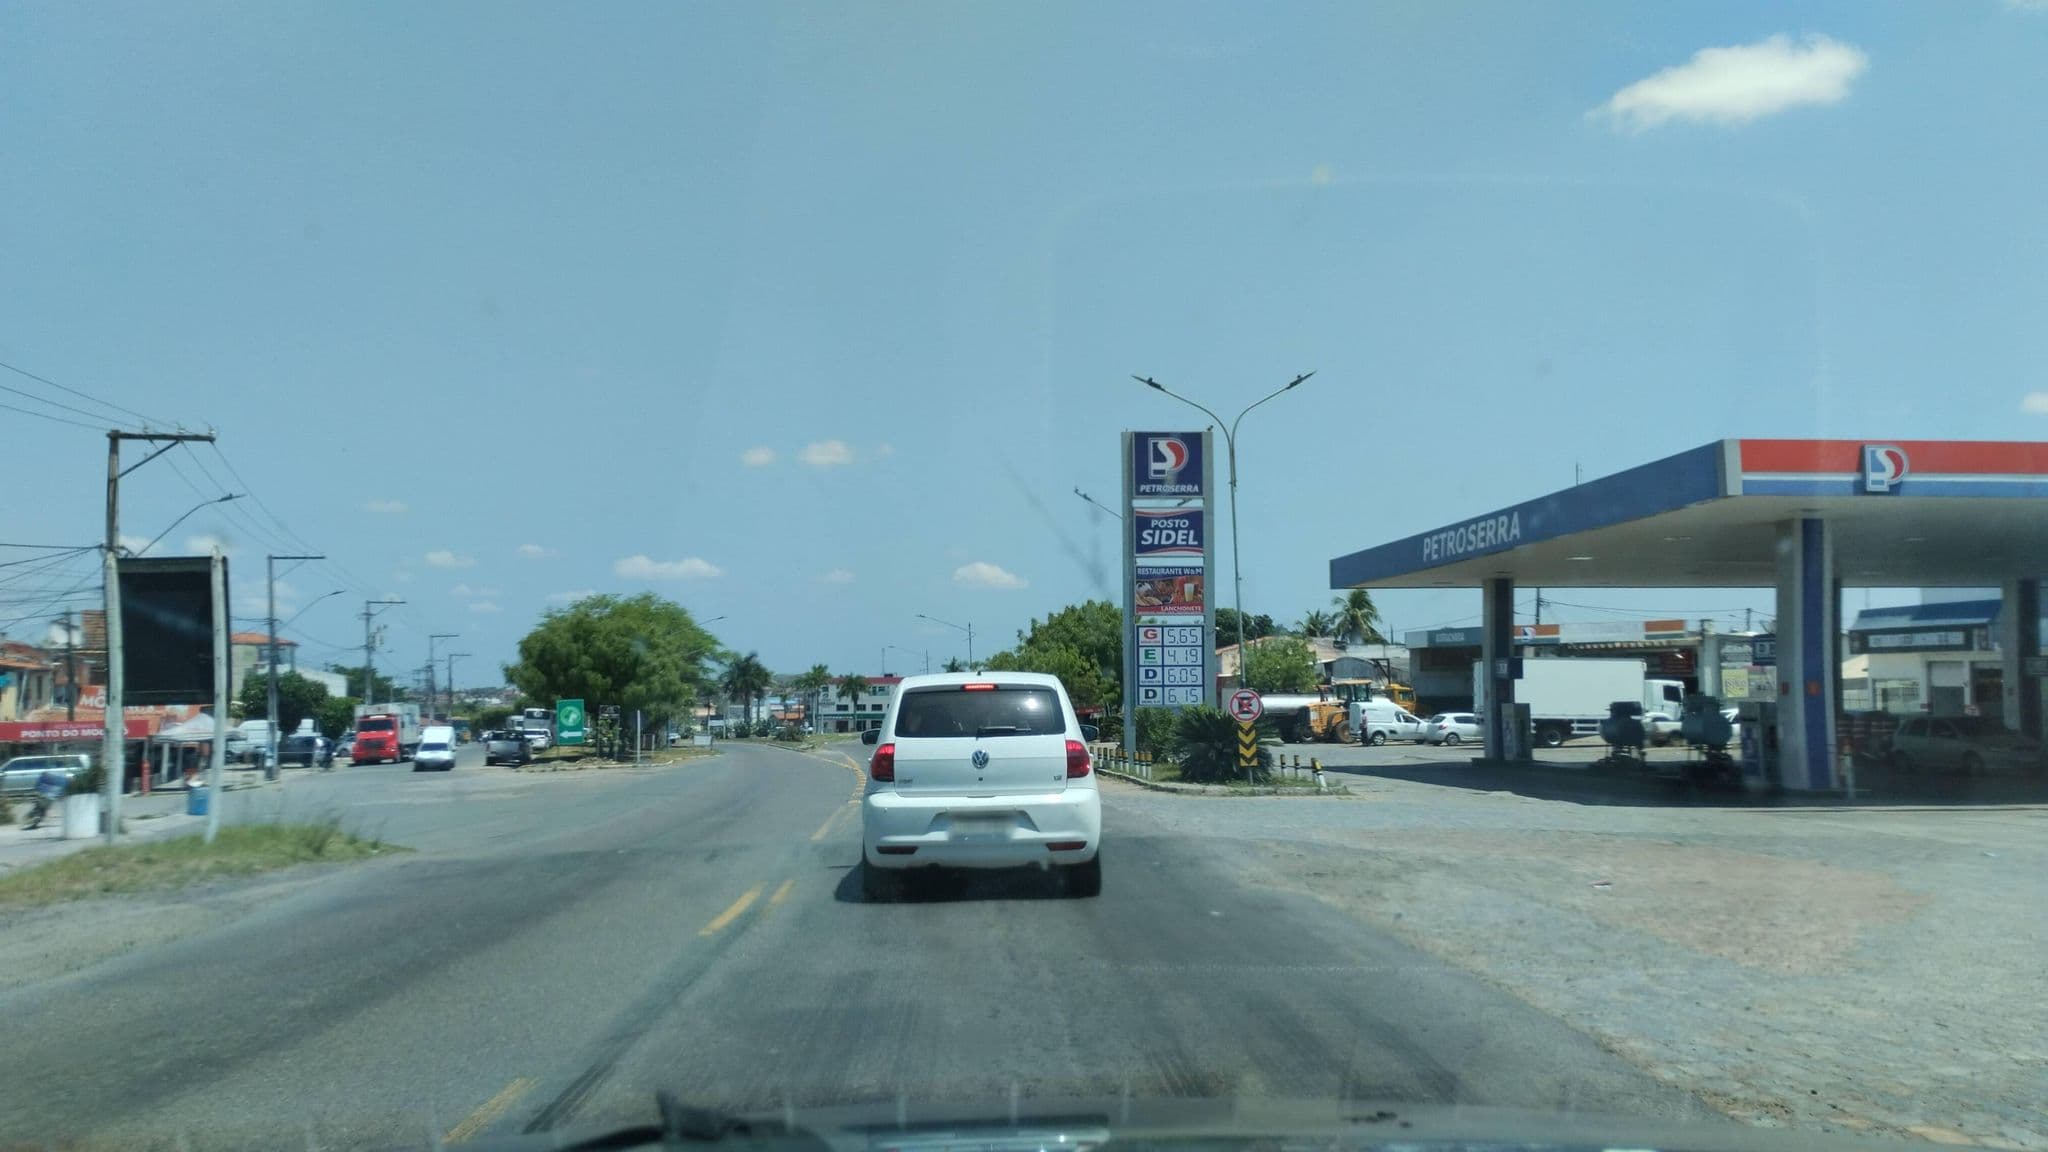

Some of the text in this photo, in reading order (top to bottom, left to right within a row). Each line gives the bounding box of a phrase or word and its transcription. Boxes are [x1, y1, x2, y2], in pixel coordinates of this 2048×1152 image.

[1140, 484, 1199, 493] PETROSERRA
[1151, 519, 1189, 528] POSTO
[1141, 530, 1198, 545] SIDEL
[1423, 511, 1520, 562] PETROSERRA
[1137, 567, 1182, 575] RESTAURANTE
[1144, 629, 1157, 639] G
[1144, 649, 1156, 659] E
[1144, 669, 1157, 679] D
[1144, 689, 1157, 699] D
[20, 730, 60, 738] PONTO
